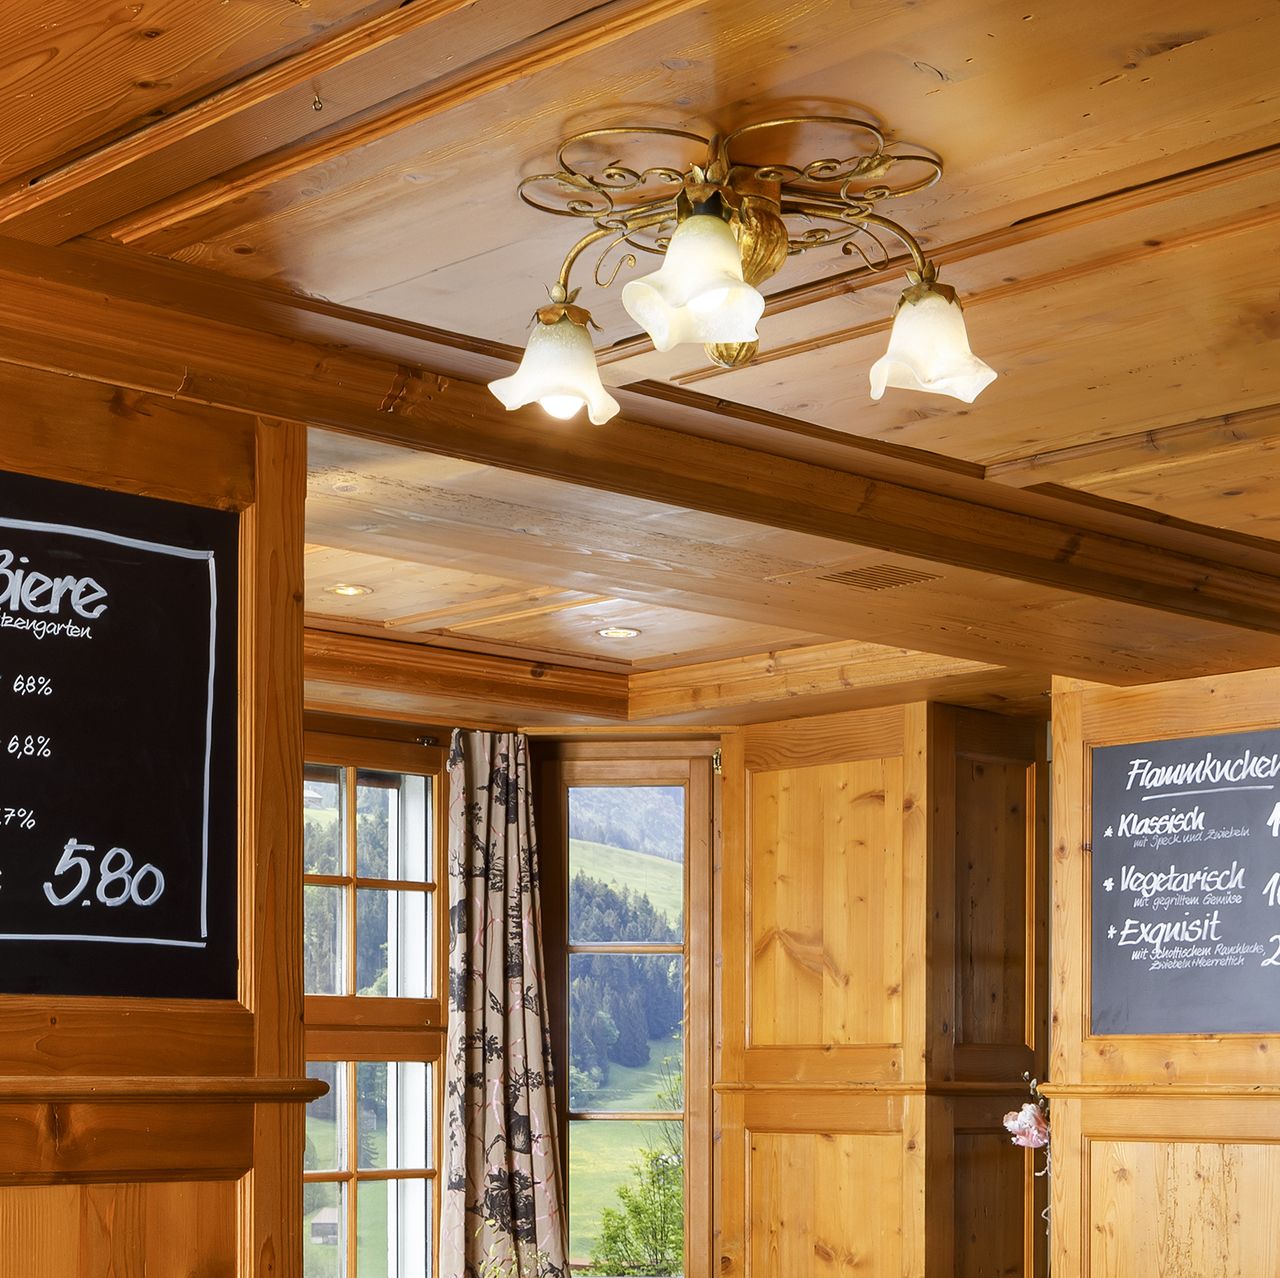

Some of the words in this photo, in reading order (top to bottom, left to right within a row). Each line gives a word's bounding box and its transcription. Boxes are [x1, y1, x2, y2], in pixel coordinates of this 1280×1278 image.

[13, 674, 53, 696] 6,8%
[6, 735, 52, 758] 6,8%
[1117, 806, 1206, 837] Klassisch
[1133, 836, 1149, 848] mit
[1150, 834, 1182, 850] Speck
[1182, 832, 1203, 843] und
[1204, 826, 1251, 841] Zwiebeln
[42, 838, 166, 908] 5.80
[1120, 860, 1246, 898] Vegetarisch
[1133, 896, 1150, 908] mit
[1152, 893, 1200, 911] gegrilltem
[1202, 891, 1243, 905] Gemüse
[1117, 910, 1223, 951] Exquisit
[1131, 948, 1148, 960] mit
